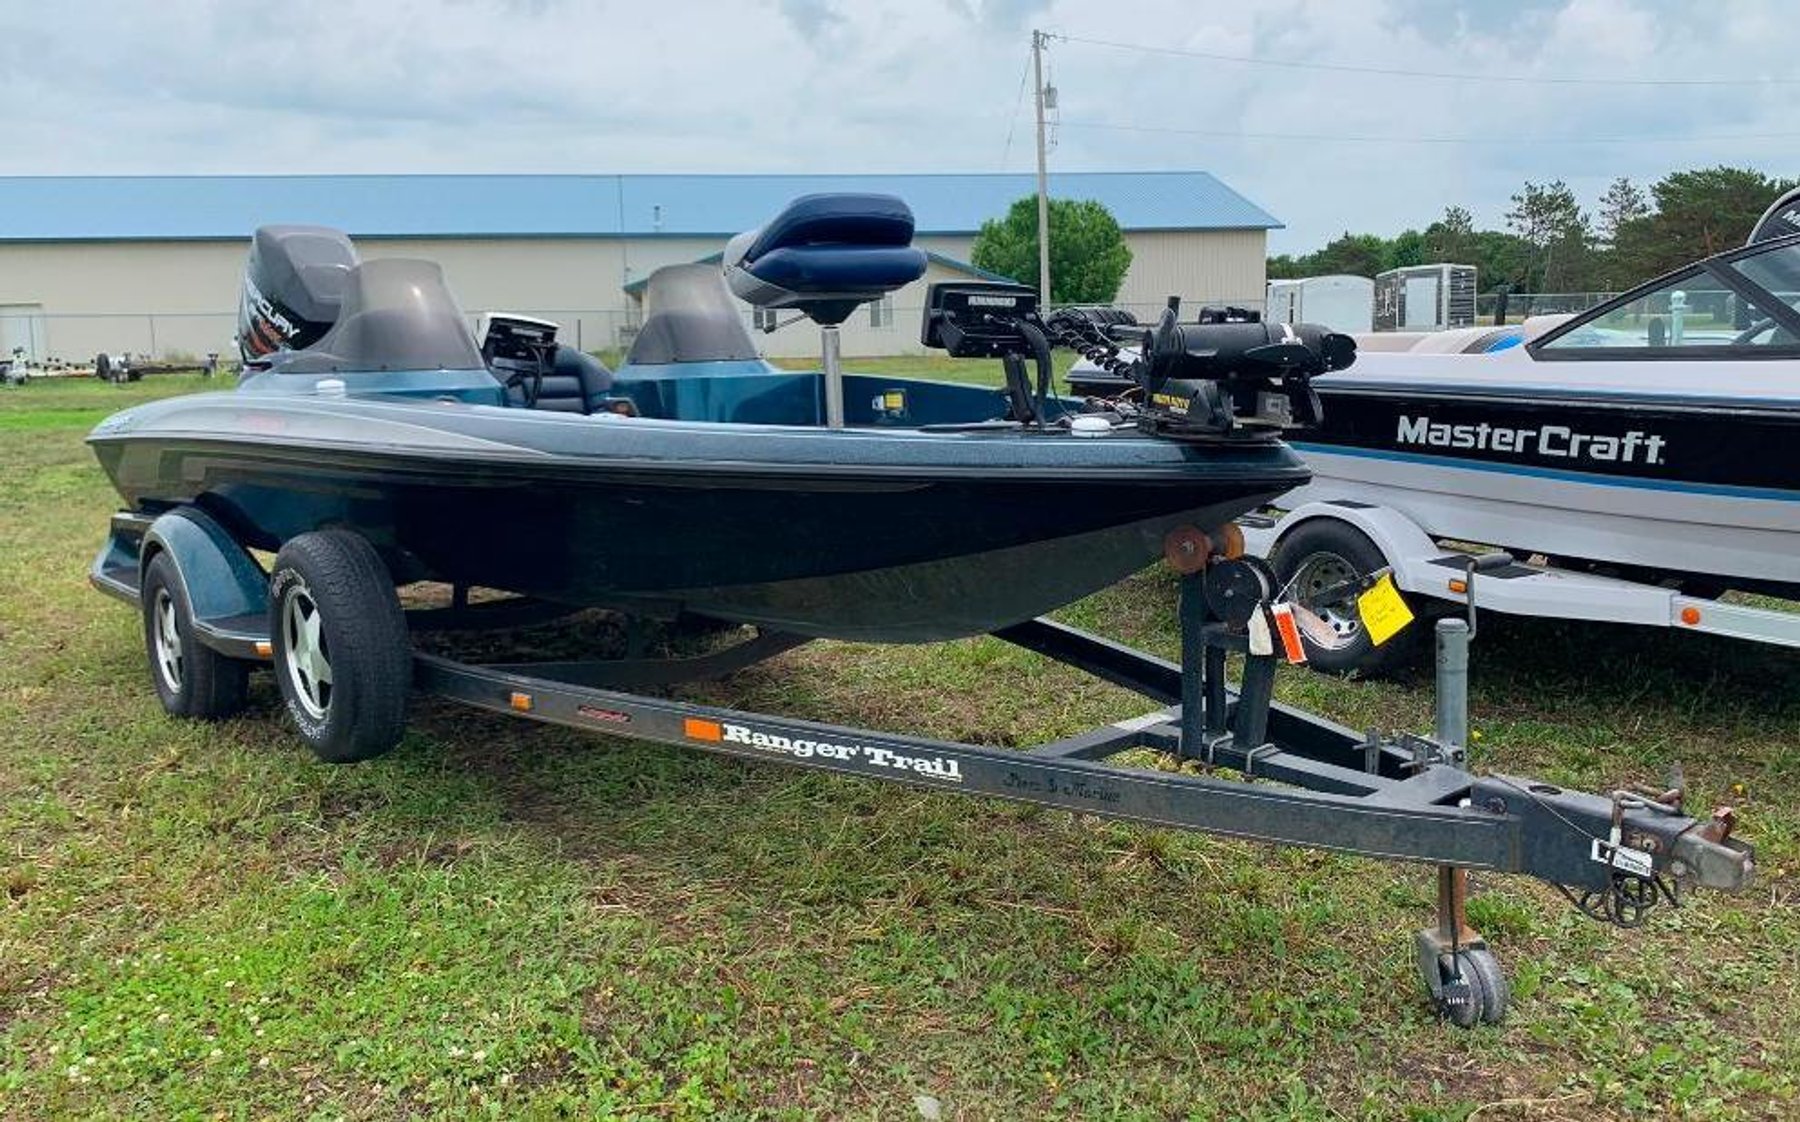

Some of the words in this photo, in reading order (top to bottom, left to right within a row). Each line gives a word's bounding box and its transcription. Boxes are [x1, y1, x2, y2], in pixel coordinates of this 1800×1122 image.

[1396, 414, 1666, 464] MasterCraft
[722, 722, 858, 760] Ranger
[863, 746, 963, 779] Trail
